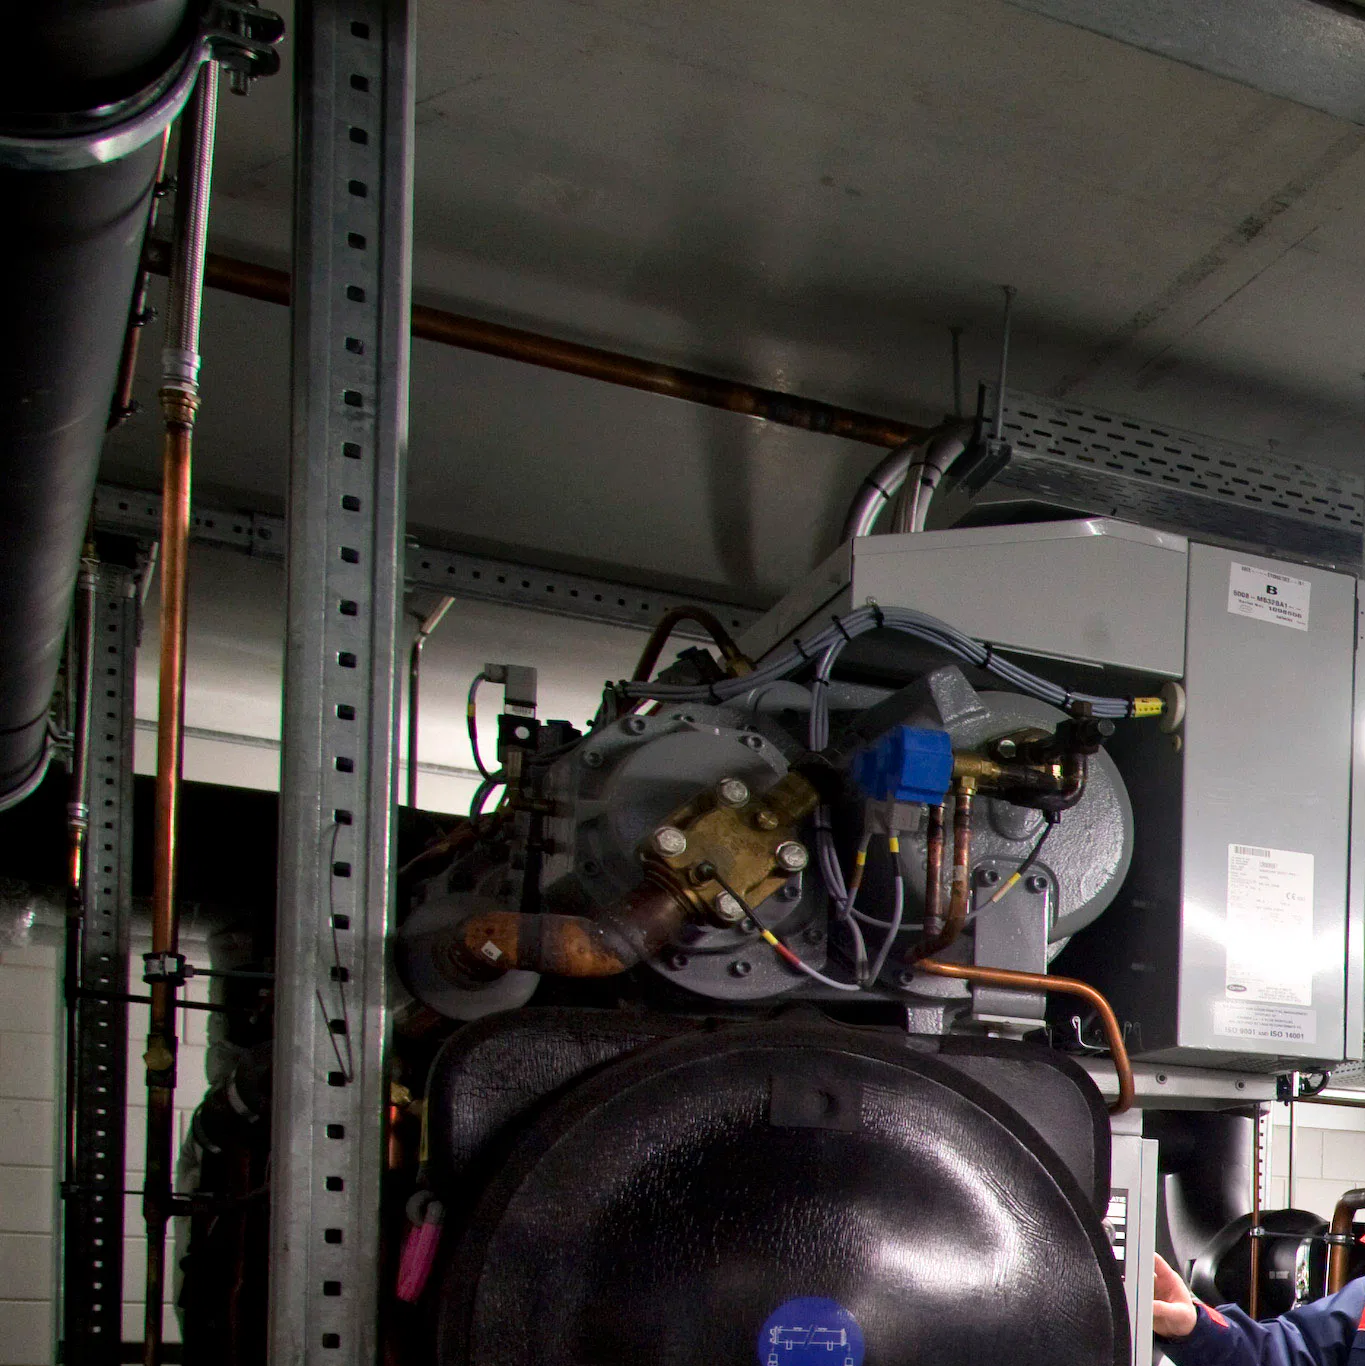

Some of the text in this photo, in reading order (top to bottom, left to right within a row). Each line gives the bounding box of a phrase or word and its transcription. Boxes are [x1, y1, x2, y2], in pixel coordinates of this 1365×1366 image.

[1266, 585, 1278, 595] B
[1225, 1026, 1238, 1034] ISO
[1240, 1027, 1256, 1036] 9001
[1270, 1030, 1284, 1038] ISO
[1285, 1032, 1305, 1040] 14001
